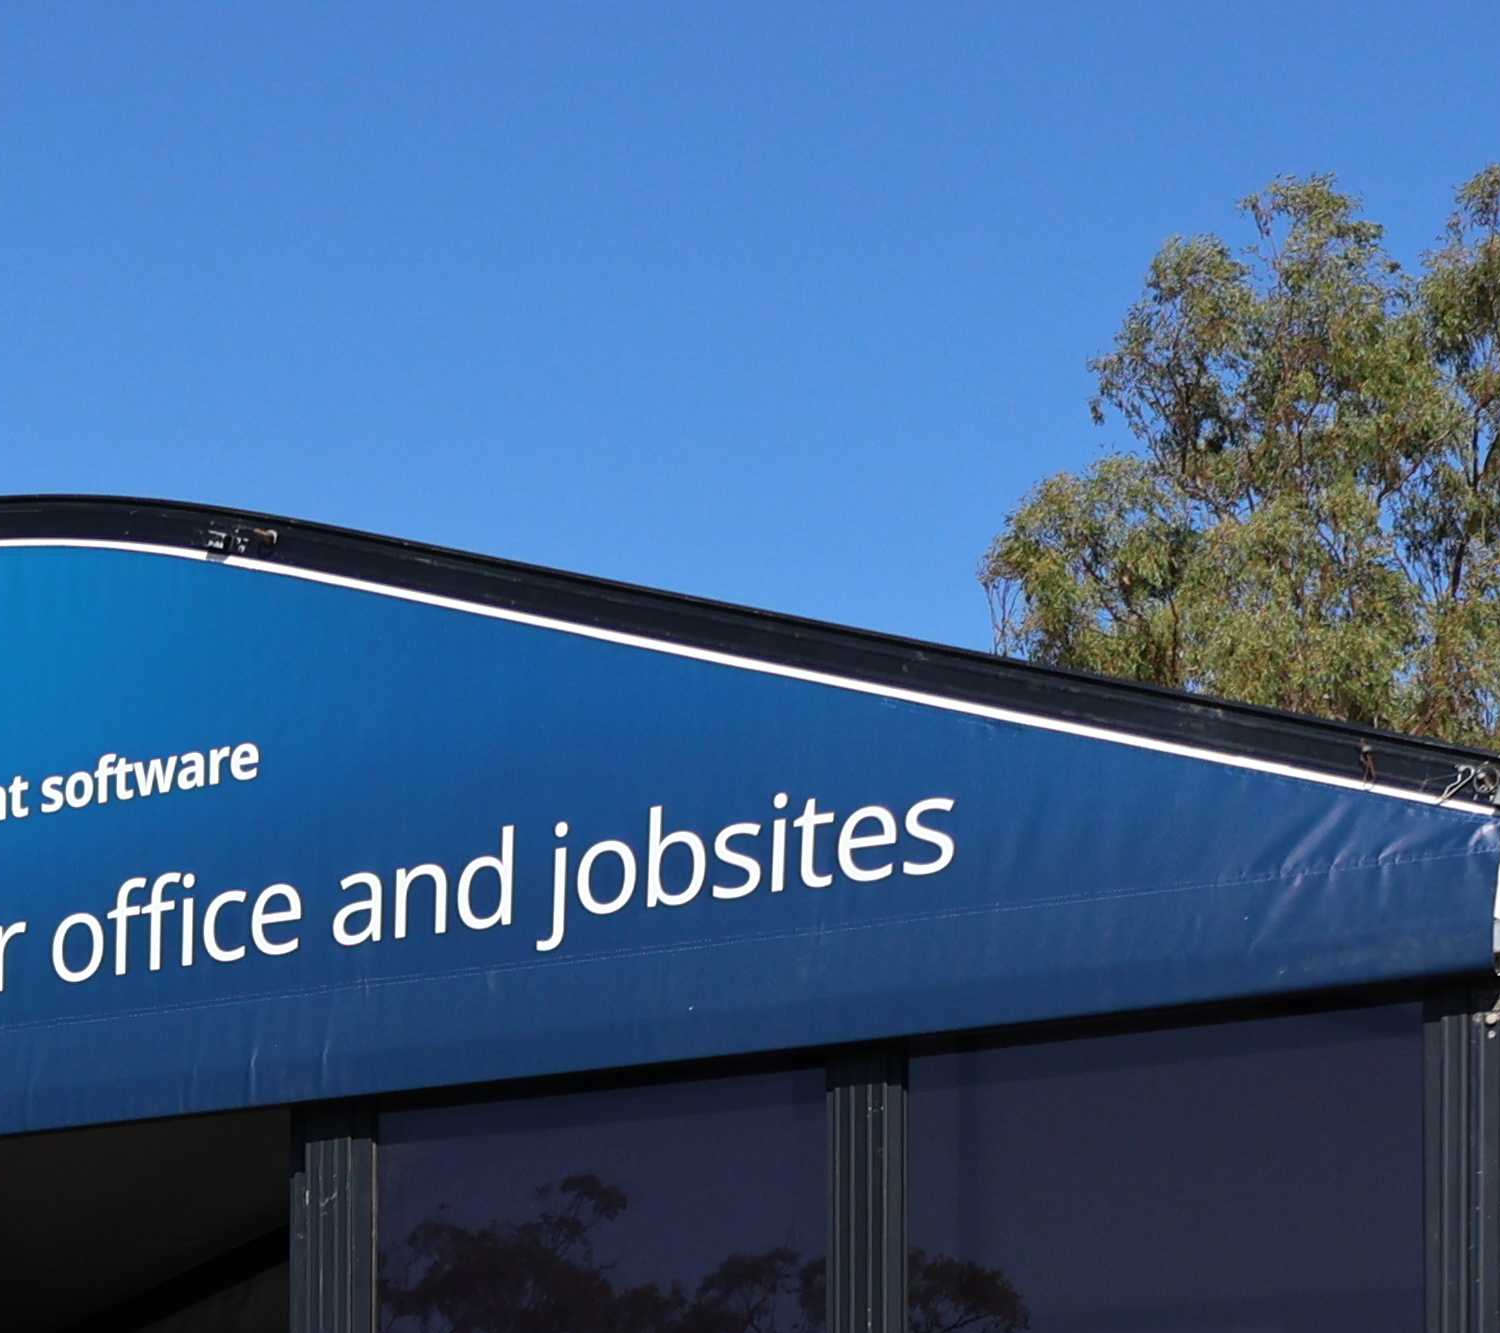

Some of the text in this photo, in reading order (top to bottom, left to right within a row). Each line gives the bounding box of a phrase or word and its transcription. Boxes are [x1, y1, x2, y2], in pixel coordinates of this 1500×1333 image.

[41, 742, 260, 814] software
[48, 870, 302, 985] office
[332, 824, 517, 948] and
[536, 792, 958, 951] jobsites
